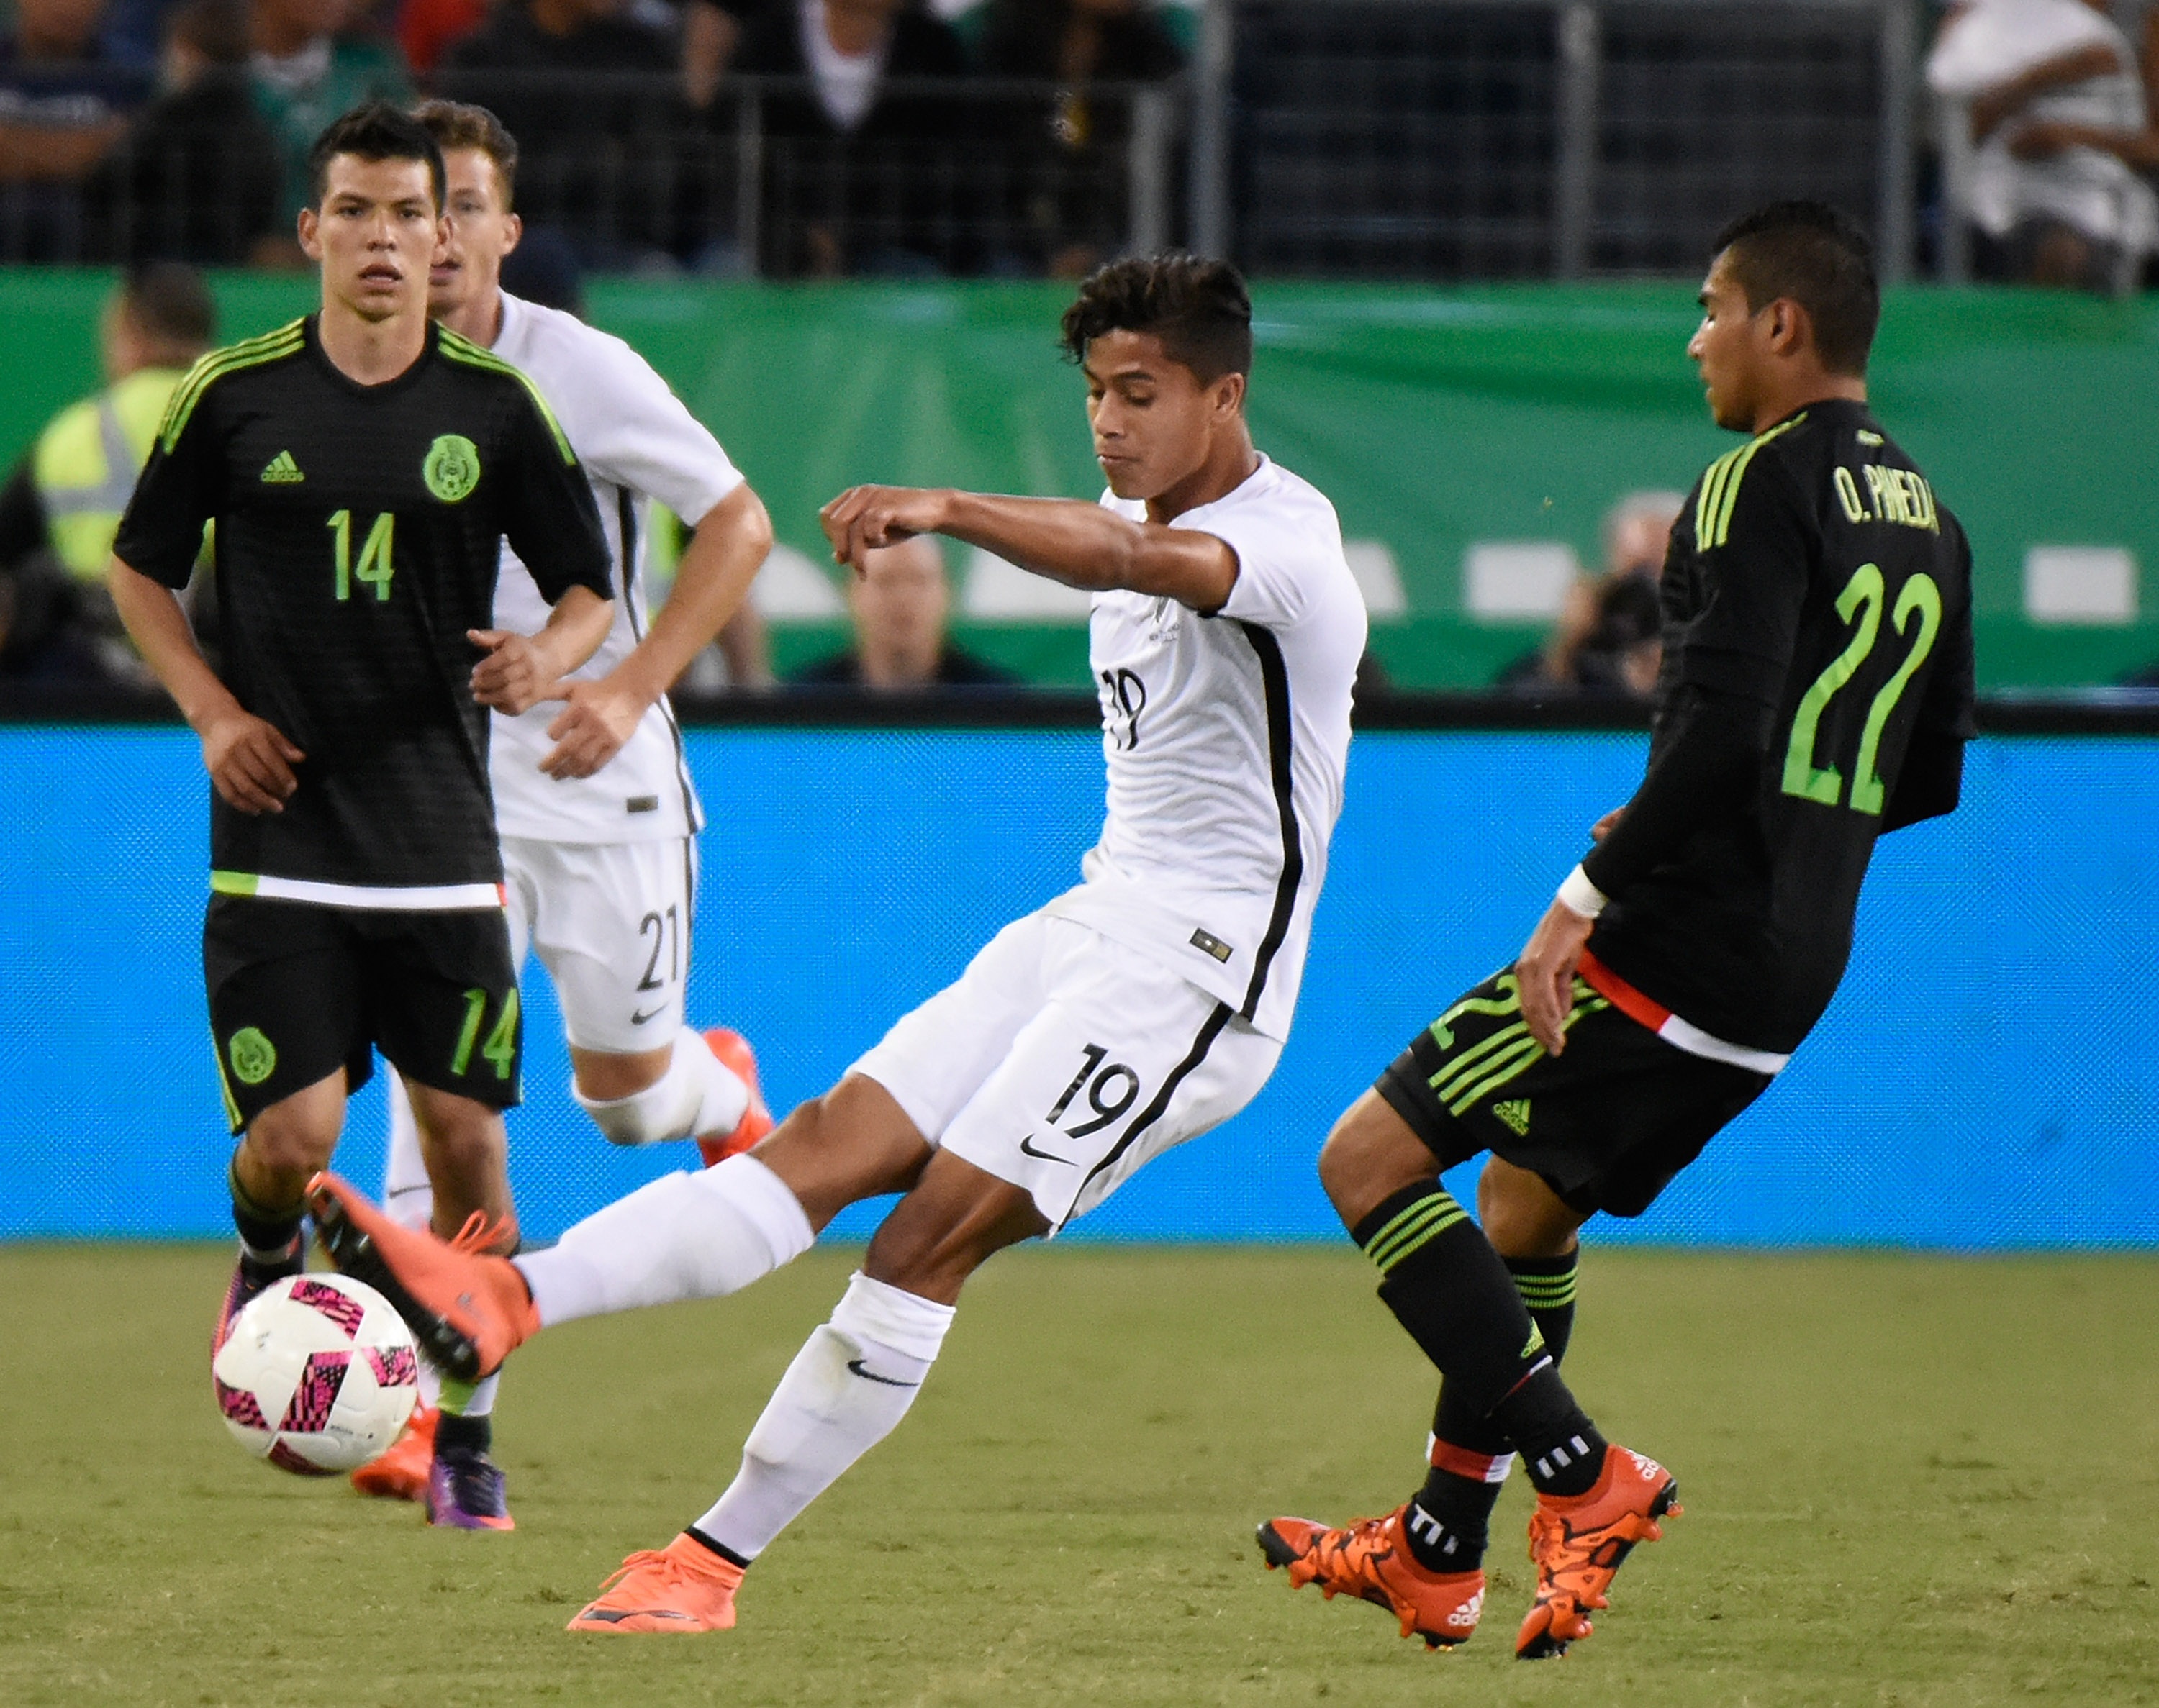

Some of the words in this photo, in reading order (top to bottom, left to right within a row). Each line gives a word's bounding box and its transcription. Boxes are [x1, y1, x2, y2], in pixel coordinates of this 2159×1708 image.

[327, 509, 394, 601] 14
[1101, 666, 1146, 752] 19
[1781, 563, 1941, 816] 22
[636, 902, 679, 992] 21
[451, 987, 518, 1080] 14
[1045, 1042, 1140, 1140] 19
